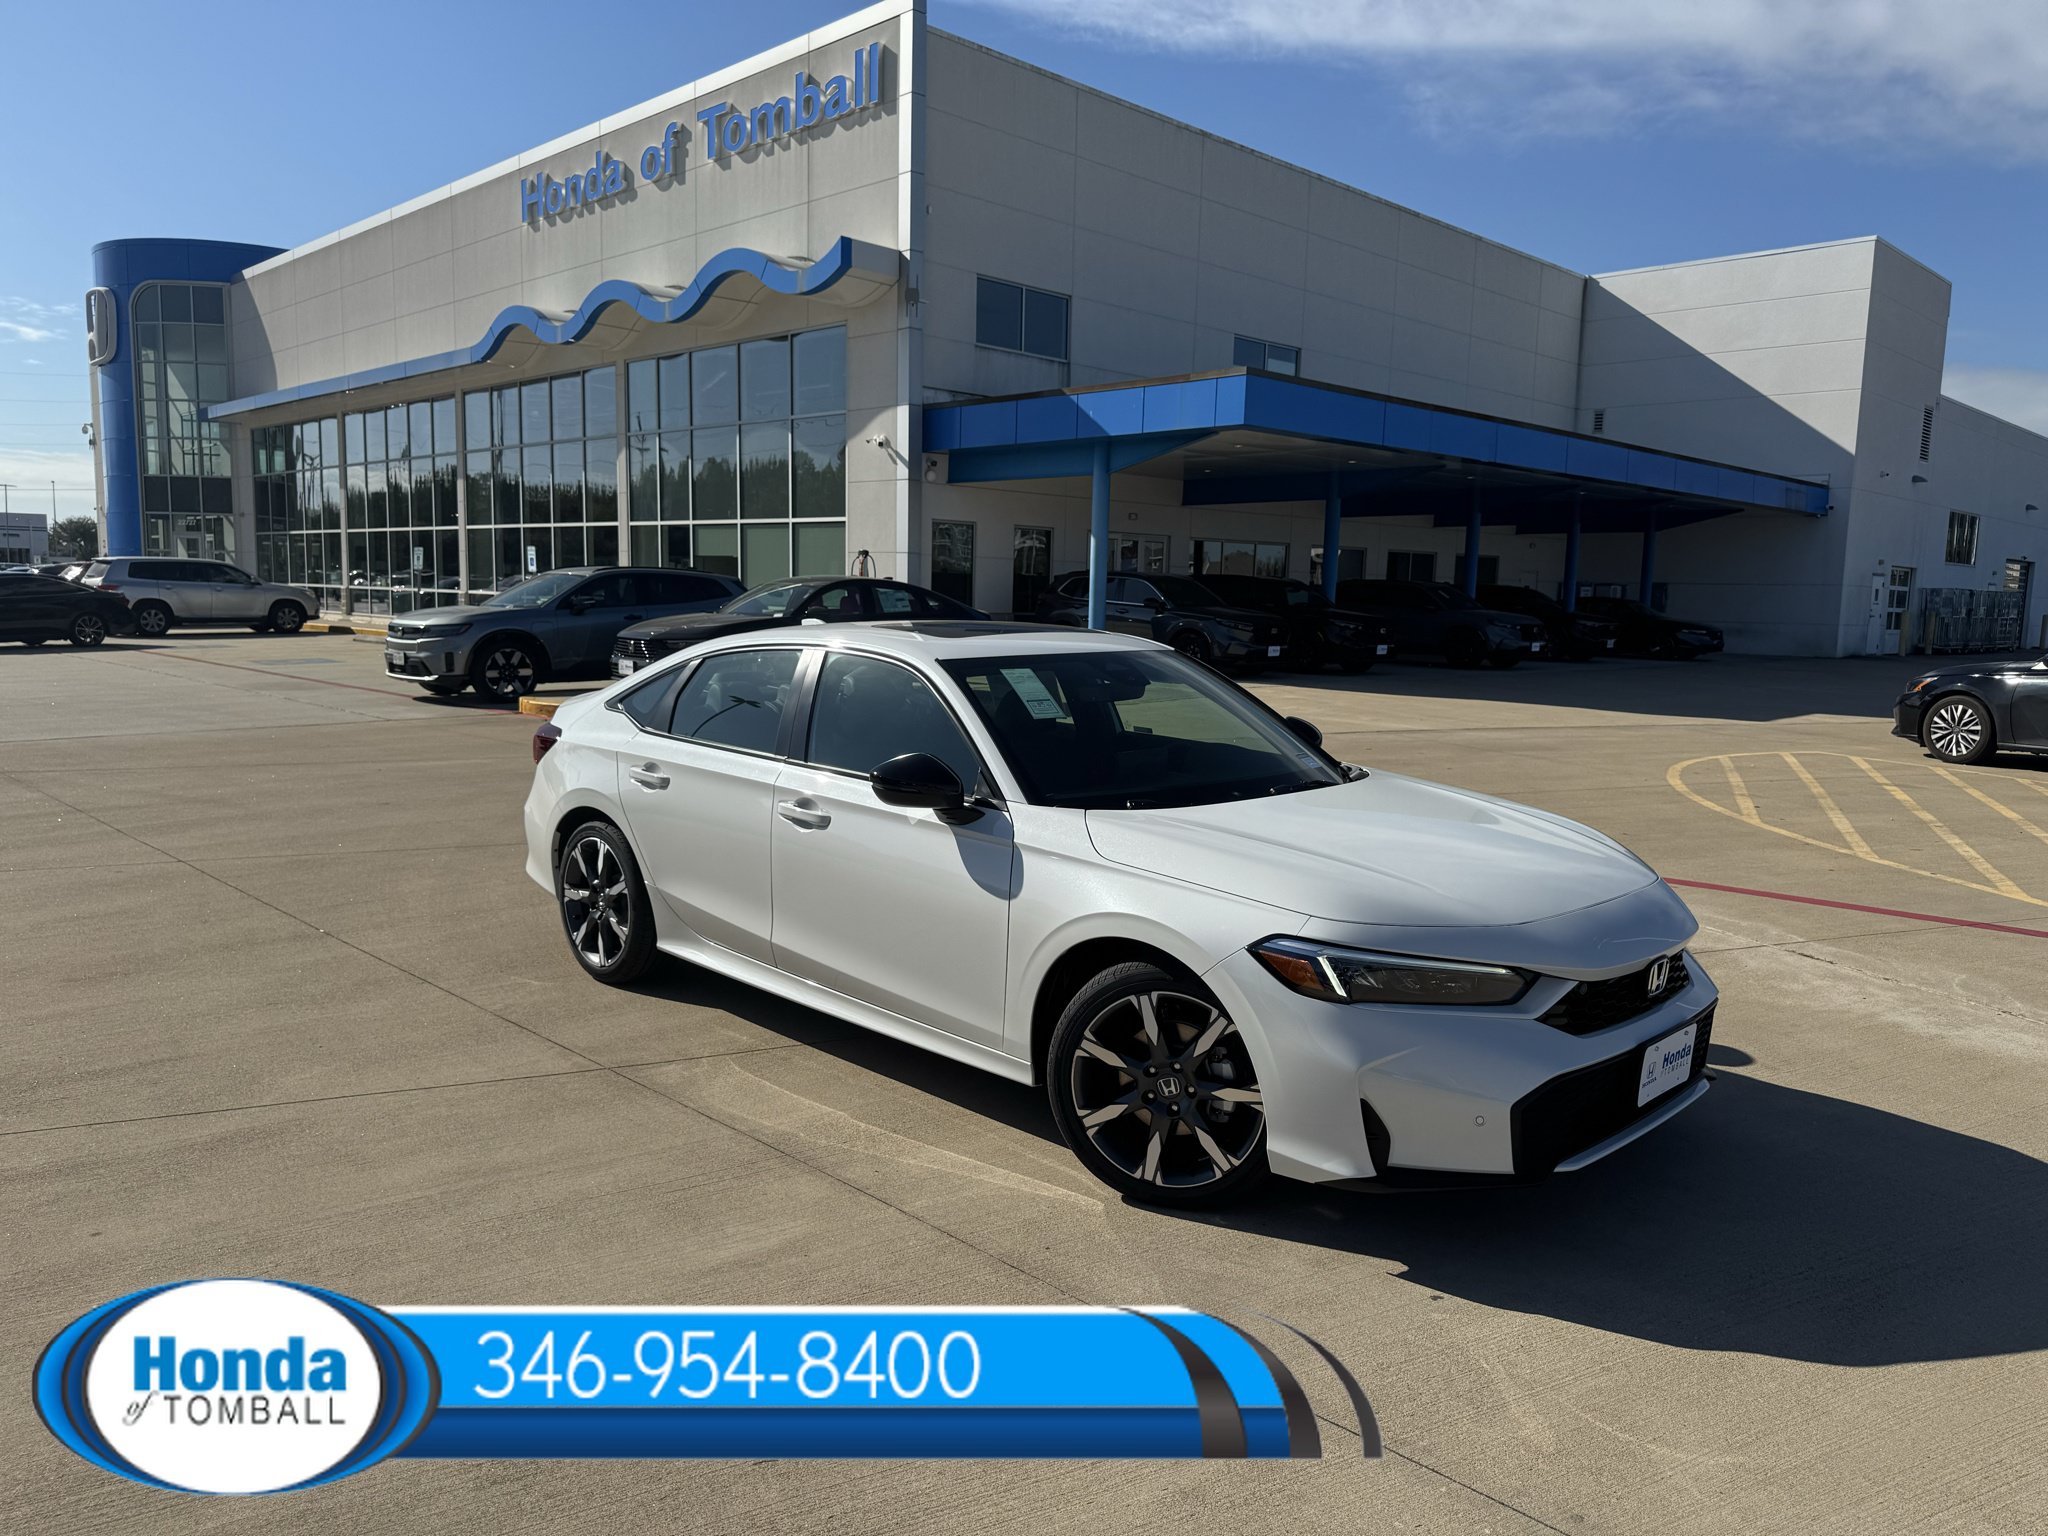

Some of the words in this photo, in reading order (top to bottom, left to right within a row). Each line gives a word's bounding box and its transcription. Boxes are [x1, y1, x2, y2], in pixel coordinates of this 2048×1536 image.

[520, 150, 626, 224] Honda
[640, 121, 682, 182] of
[696, 42, 882, 161] Tomball
[1661, 1043, 1692, 1069] Honda
